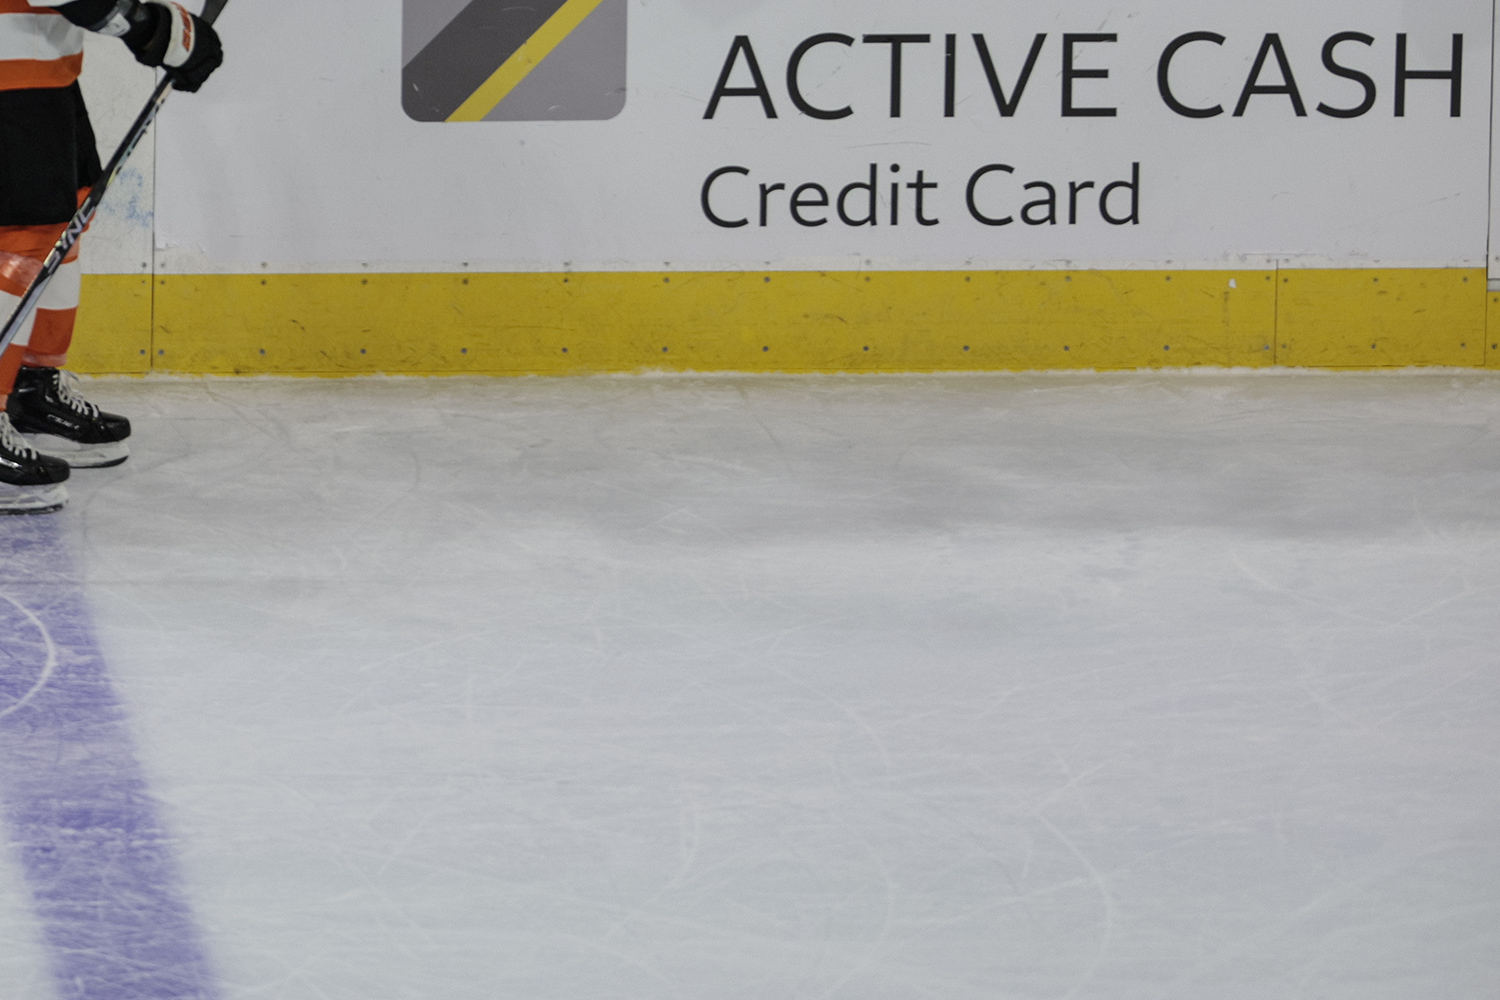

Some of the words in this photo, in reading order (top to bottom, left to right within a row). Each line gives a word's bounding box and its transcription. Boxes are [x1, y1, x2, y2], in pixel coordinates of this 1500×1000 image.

[703, 33, 1118, 121] ACTIVE
[1158, 31, 1464, 119] CASH
[700, 164, 940, 229] Credit
[966, 162, 1140, 227] Card
